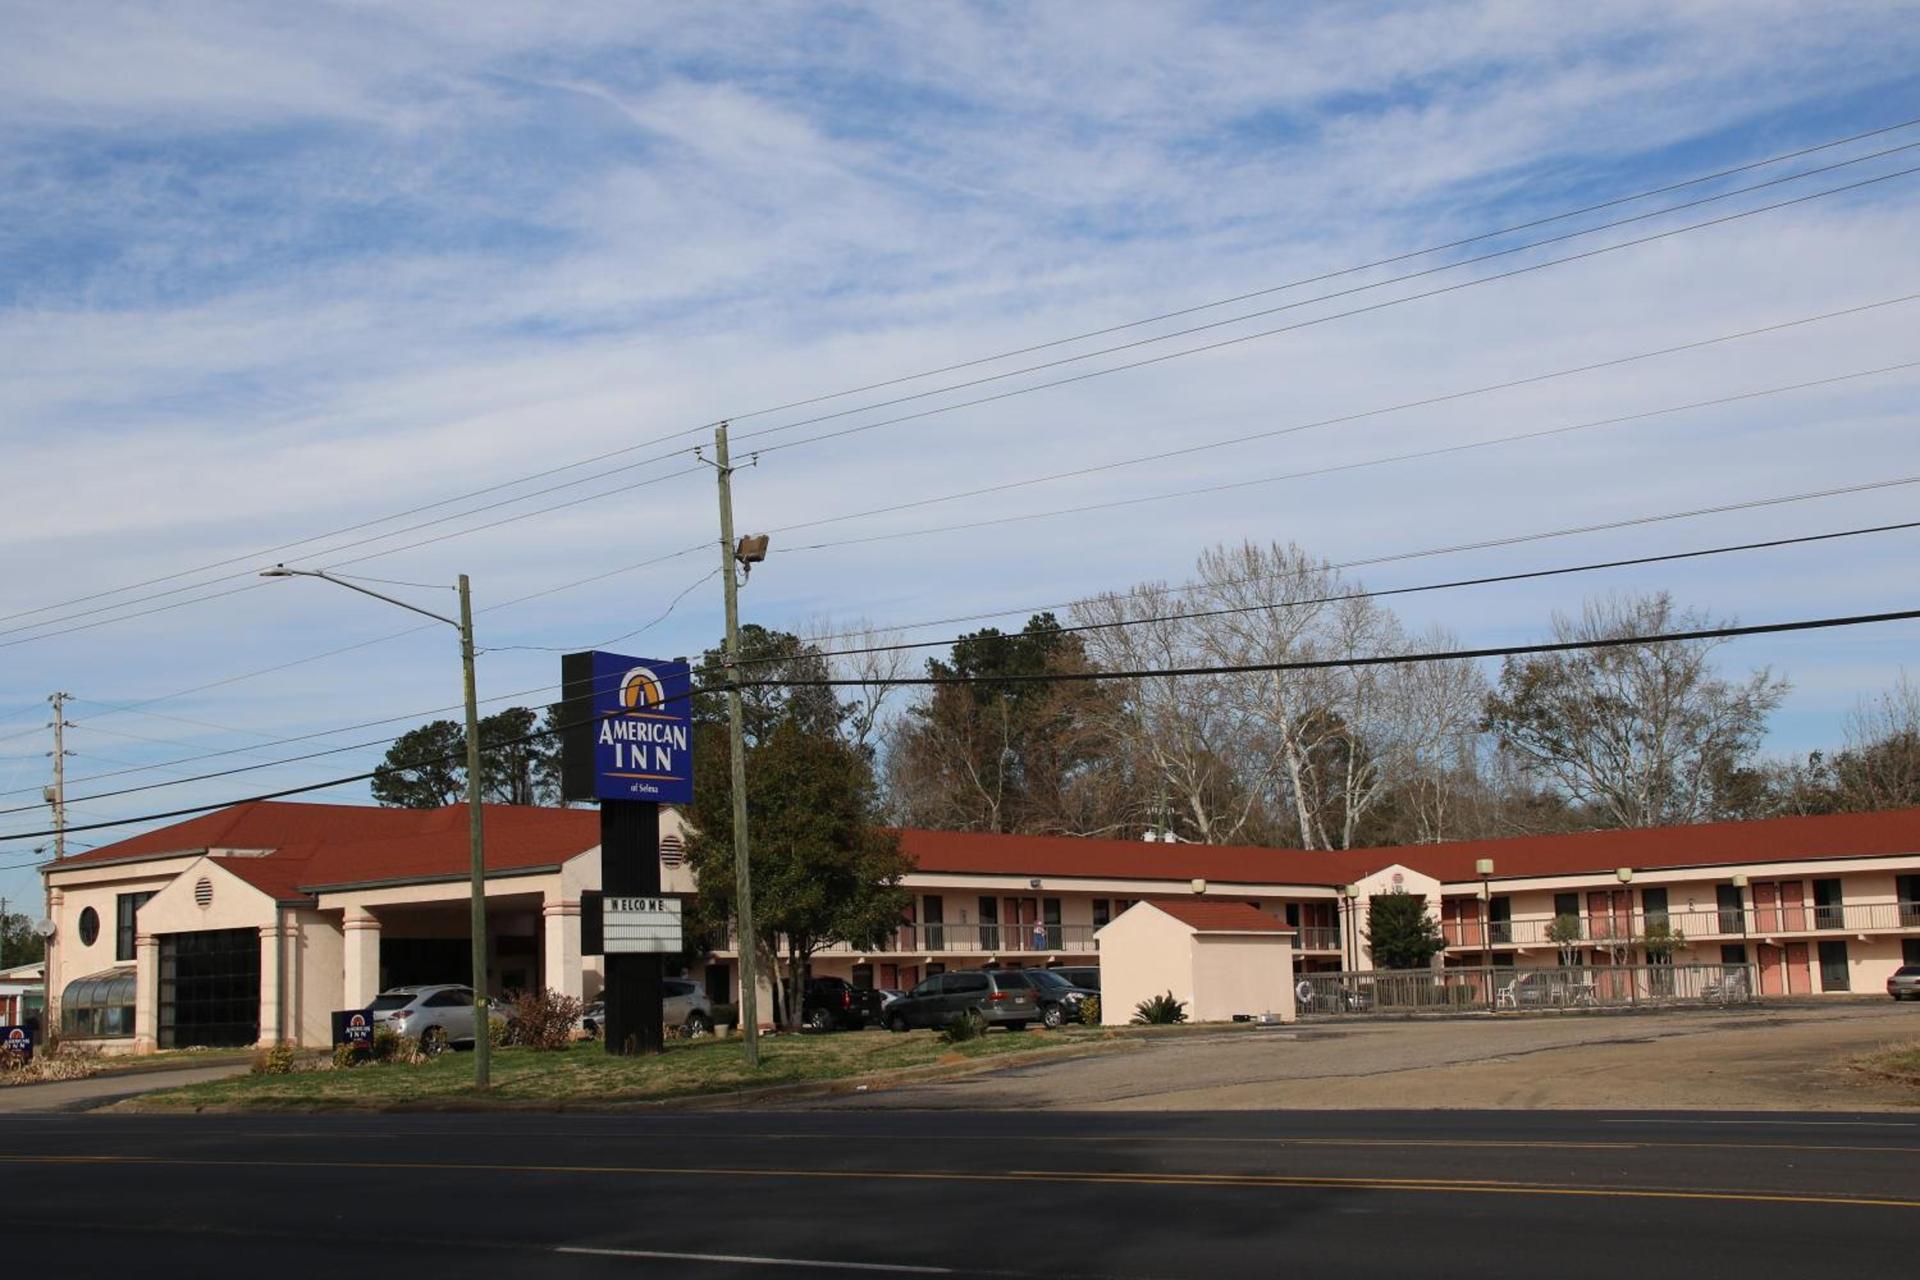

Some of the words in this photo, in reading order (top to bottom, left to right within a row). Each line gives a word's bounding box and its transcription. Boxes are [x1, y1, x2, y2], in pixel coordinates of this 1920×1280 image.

[599, 718, 687, 751] AMERICAN
[616, 743, 672, 771] INN
[612, 899, 664, 911] WELCOME
